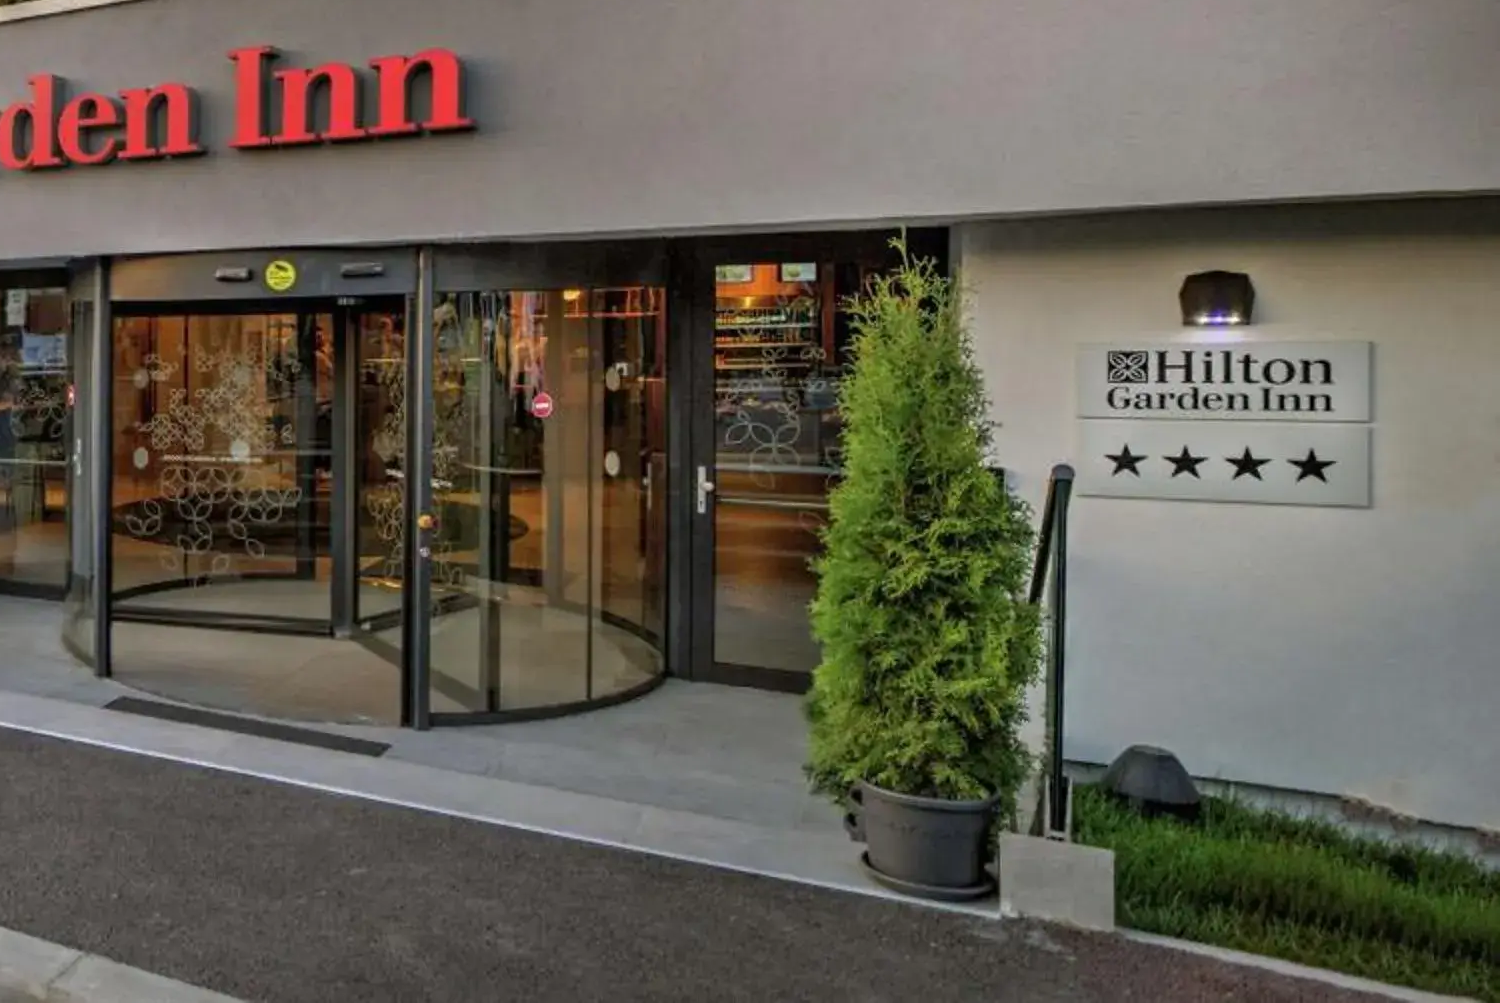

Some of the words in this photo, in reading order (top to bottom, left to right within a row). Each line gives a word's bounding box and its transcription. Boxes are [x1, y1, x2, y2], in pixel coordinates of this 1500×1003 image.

[228, 45, 472, 149] Inn
[1154, 349, 1335, 386] Hilton
[1106, 385, 1251, 411] Garden
[1260, 386, 1335, 413] Inn
